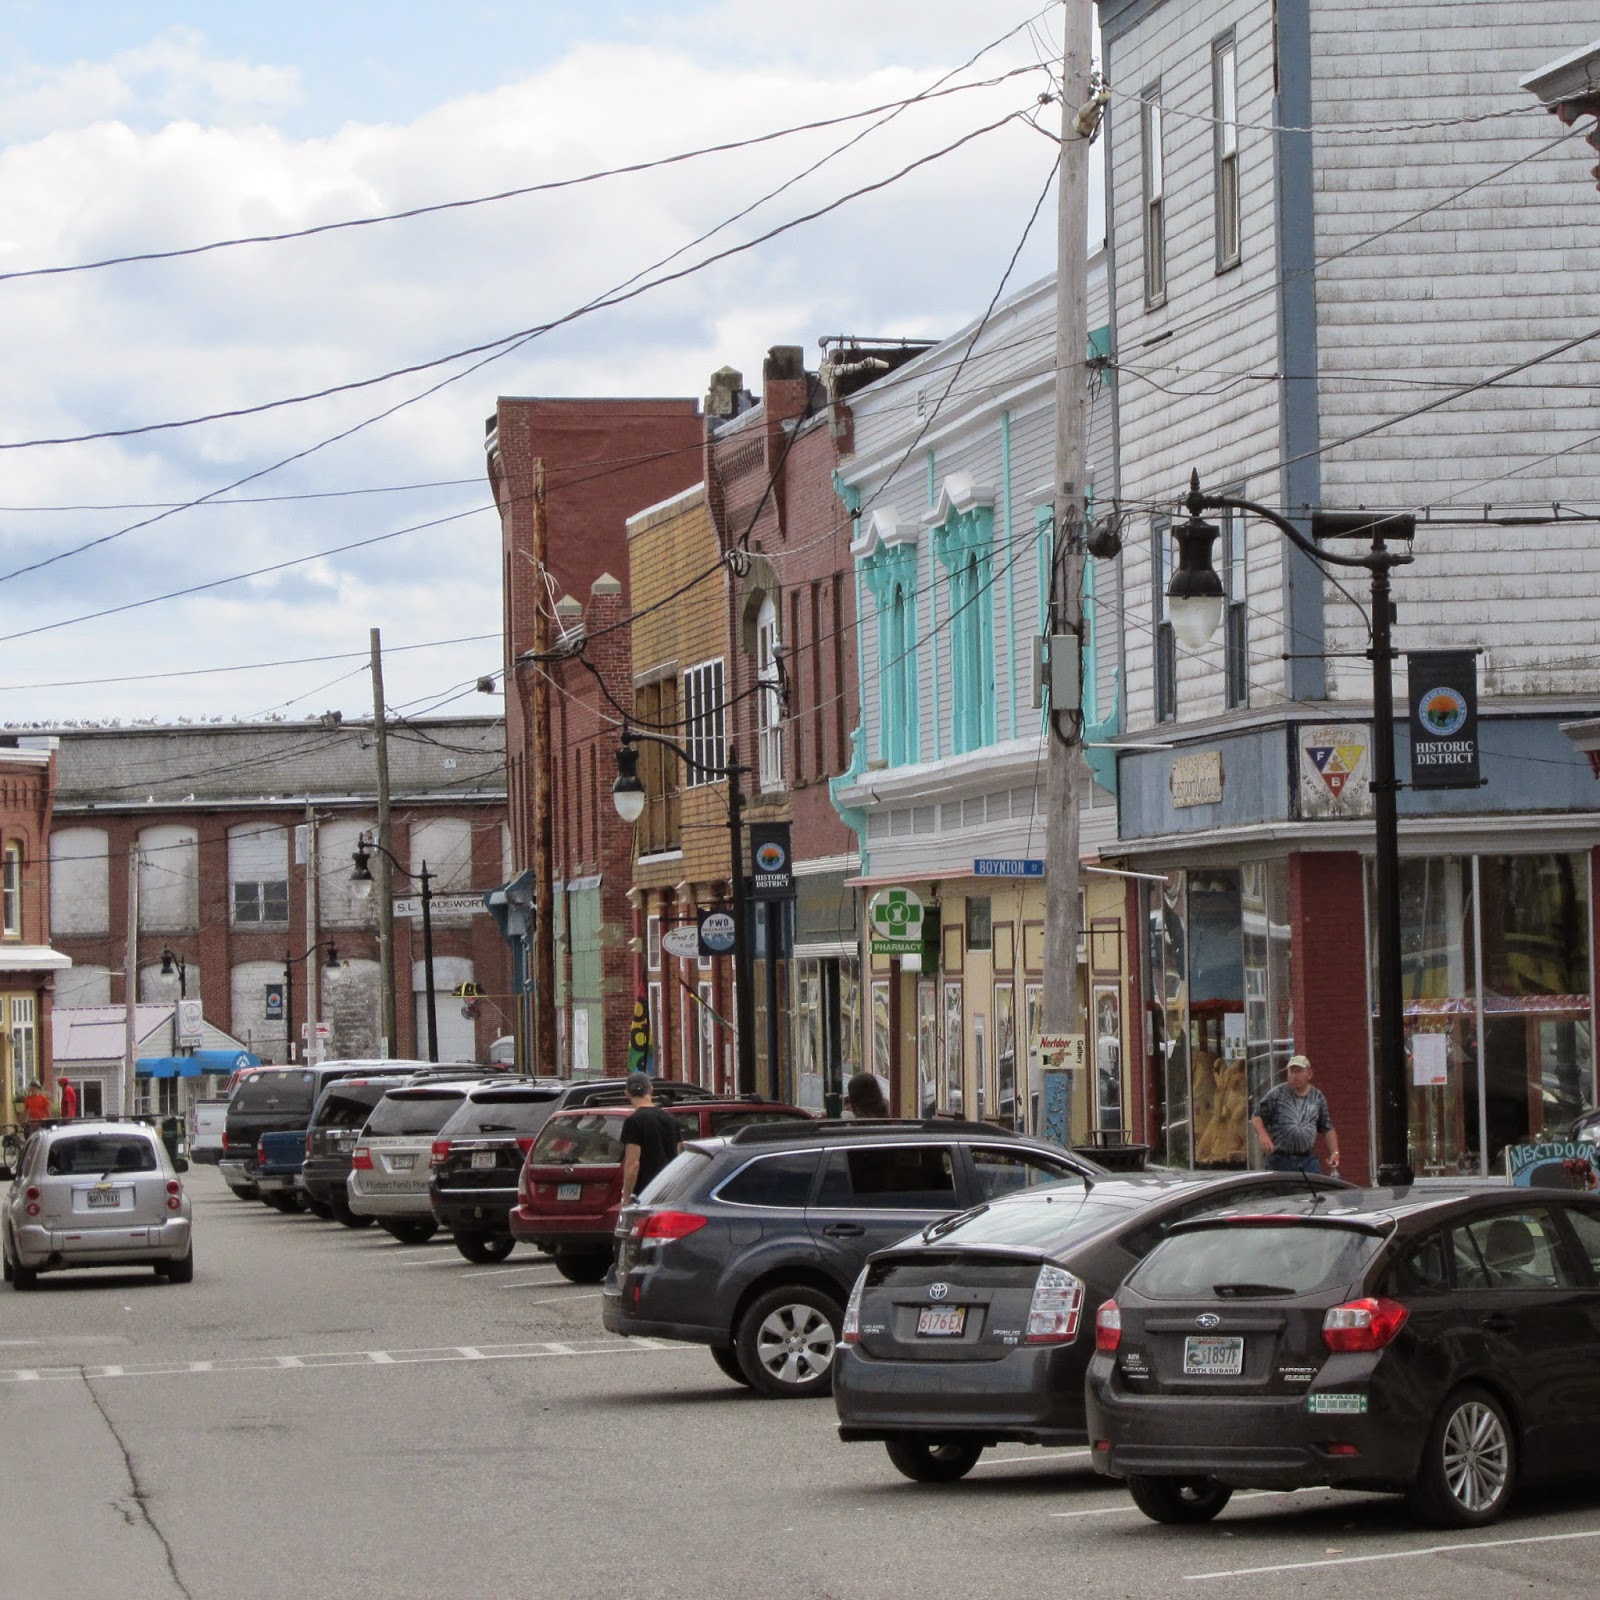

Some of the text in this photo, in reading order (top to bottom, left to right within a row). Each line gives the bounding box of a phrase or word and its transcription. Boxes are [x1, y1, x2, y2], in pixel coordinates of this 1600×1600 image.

[1312, 728, 1357, 740] KNIGHTS
[1313, 738, 1356, 746] PYTHIAS
[1416, 741, 1474, 753] HISTORIC
[1316, 751, 1325, 761] F
[1417, 753, 1474, 765] DISTRICT
[1331, 777, 1341, 787] B
[979, 860, 1025, 874] BOYNTON
[755, 873, 790, 882] HISTORIC
[756, 880, 789, 888] DISTRICT
[422, 900, 486, 909] ADSWORT
[709, 918, 729, 927] PWD
[671, 933, 688, 942] Port
[874, 943, 922, 951] PHARMACY
[1040, 1036, 1072, 1049] Nextdoor
[1076, 1039, 1085, 1065] Gallery
[1511, 1143, 1598, 1174] NEXTDOOR
